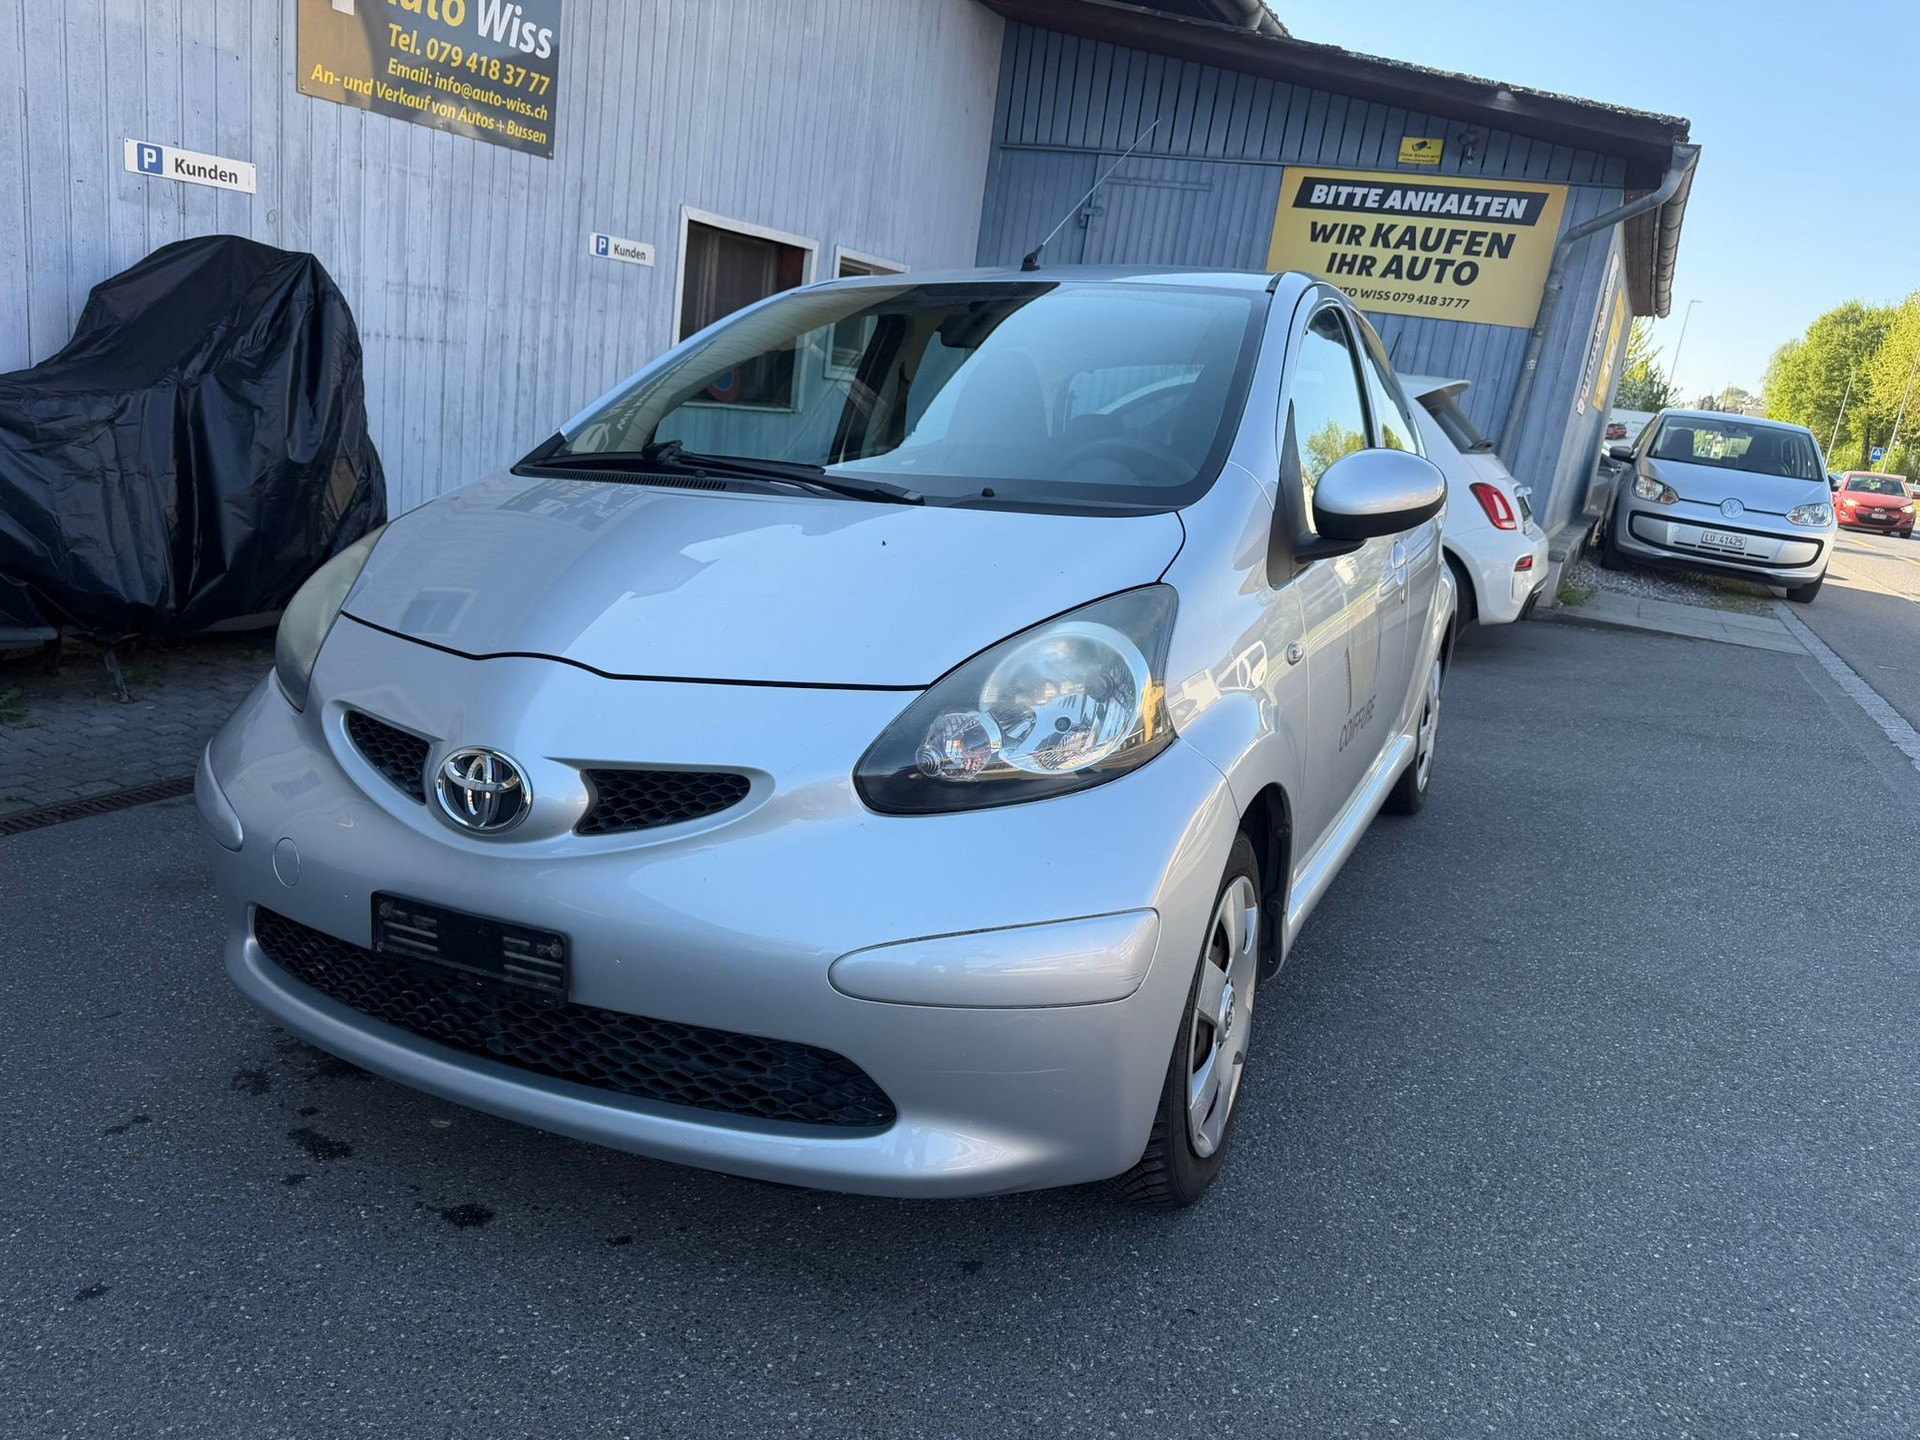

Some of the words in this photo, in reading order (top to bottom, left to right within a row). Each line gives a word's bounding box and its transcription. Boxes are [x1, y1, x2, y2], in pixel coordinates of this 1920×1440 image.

[478, 0, 553, 59] Wiss
[388, 23, 421, 56] Tel.
[426, 38, 463, 67] 079
[466, 52, 501, 80] 418
[503, 64, 527, 88] 37
[528, 72, 551, 95] 77
[311, 64, 341, 85] An-
[343, 76, 374, 96] und
[376, 81, 431, 111] Verkauf
[431, 101, 456, 119] von
[458, 107, 495, 130] Autos
[507, 120, 547, 144] Bussen
[388, 58, 433, 86] Email:
[434, 72, 548, 121] info@auto-wiss.ch
[143, 147, 157, 169] P
[174, 157, 238, 184] Kunden
[1309, 184, 1383, 208] BITTE
[1382, 189, 1528, 219] ANHALTEN
[598, 237, 607, 253] P
[614, 243, 646, 260] Kunden
[1309, 221, 1366, 247] WIR
[1369, 223, 1517, 259] KAUFEN
[1325, 252, 1378, 276] IHR
[1379, 255, 1480, 286] AUTO
[1360, 288, 1391, 301] WISS
[1392, 292, 1415, 303] 079
[1415, 295, 1438, 305] 418
[1704, 533, 1715, 542] LU
[1719, 535, 1743, 547] 41425
